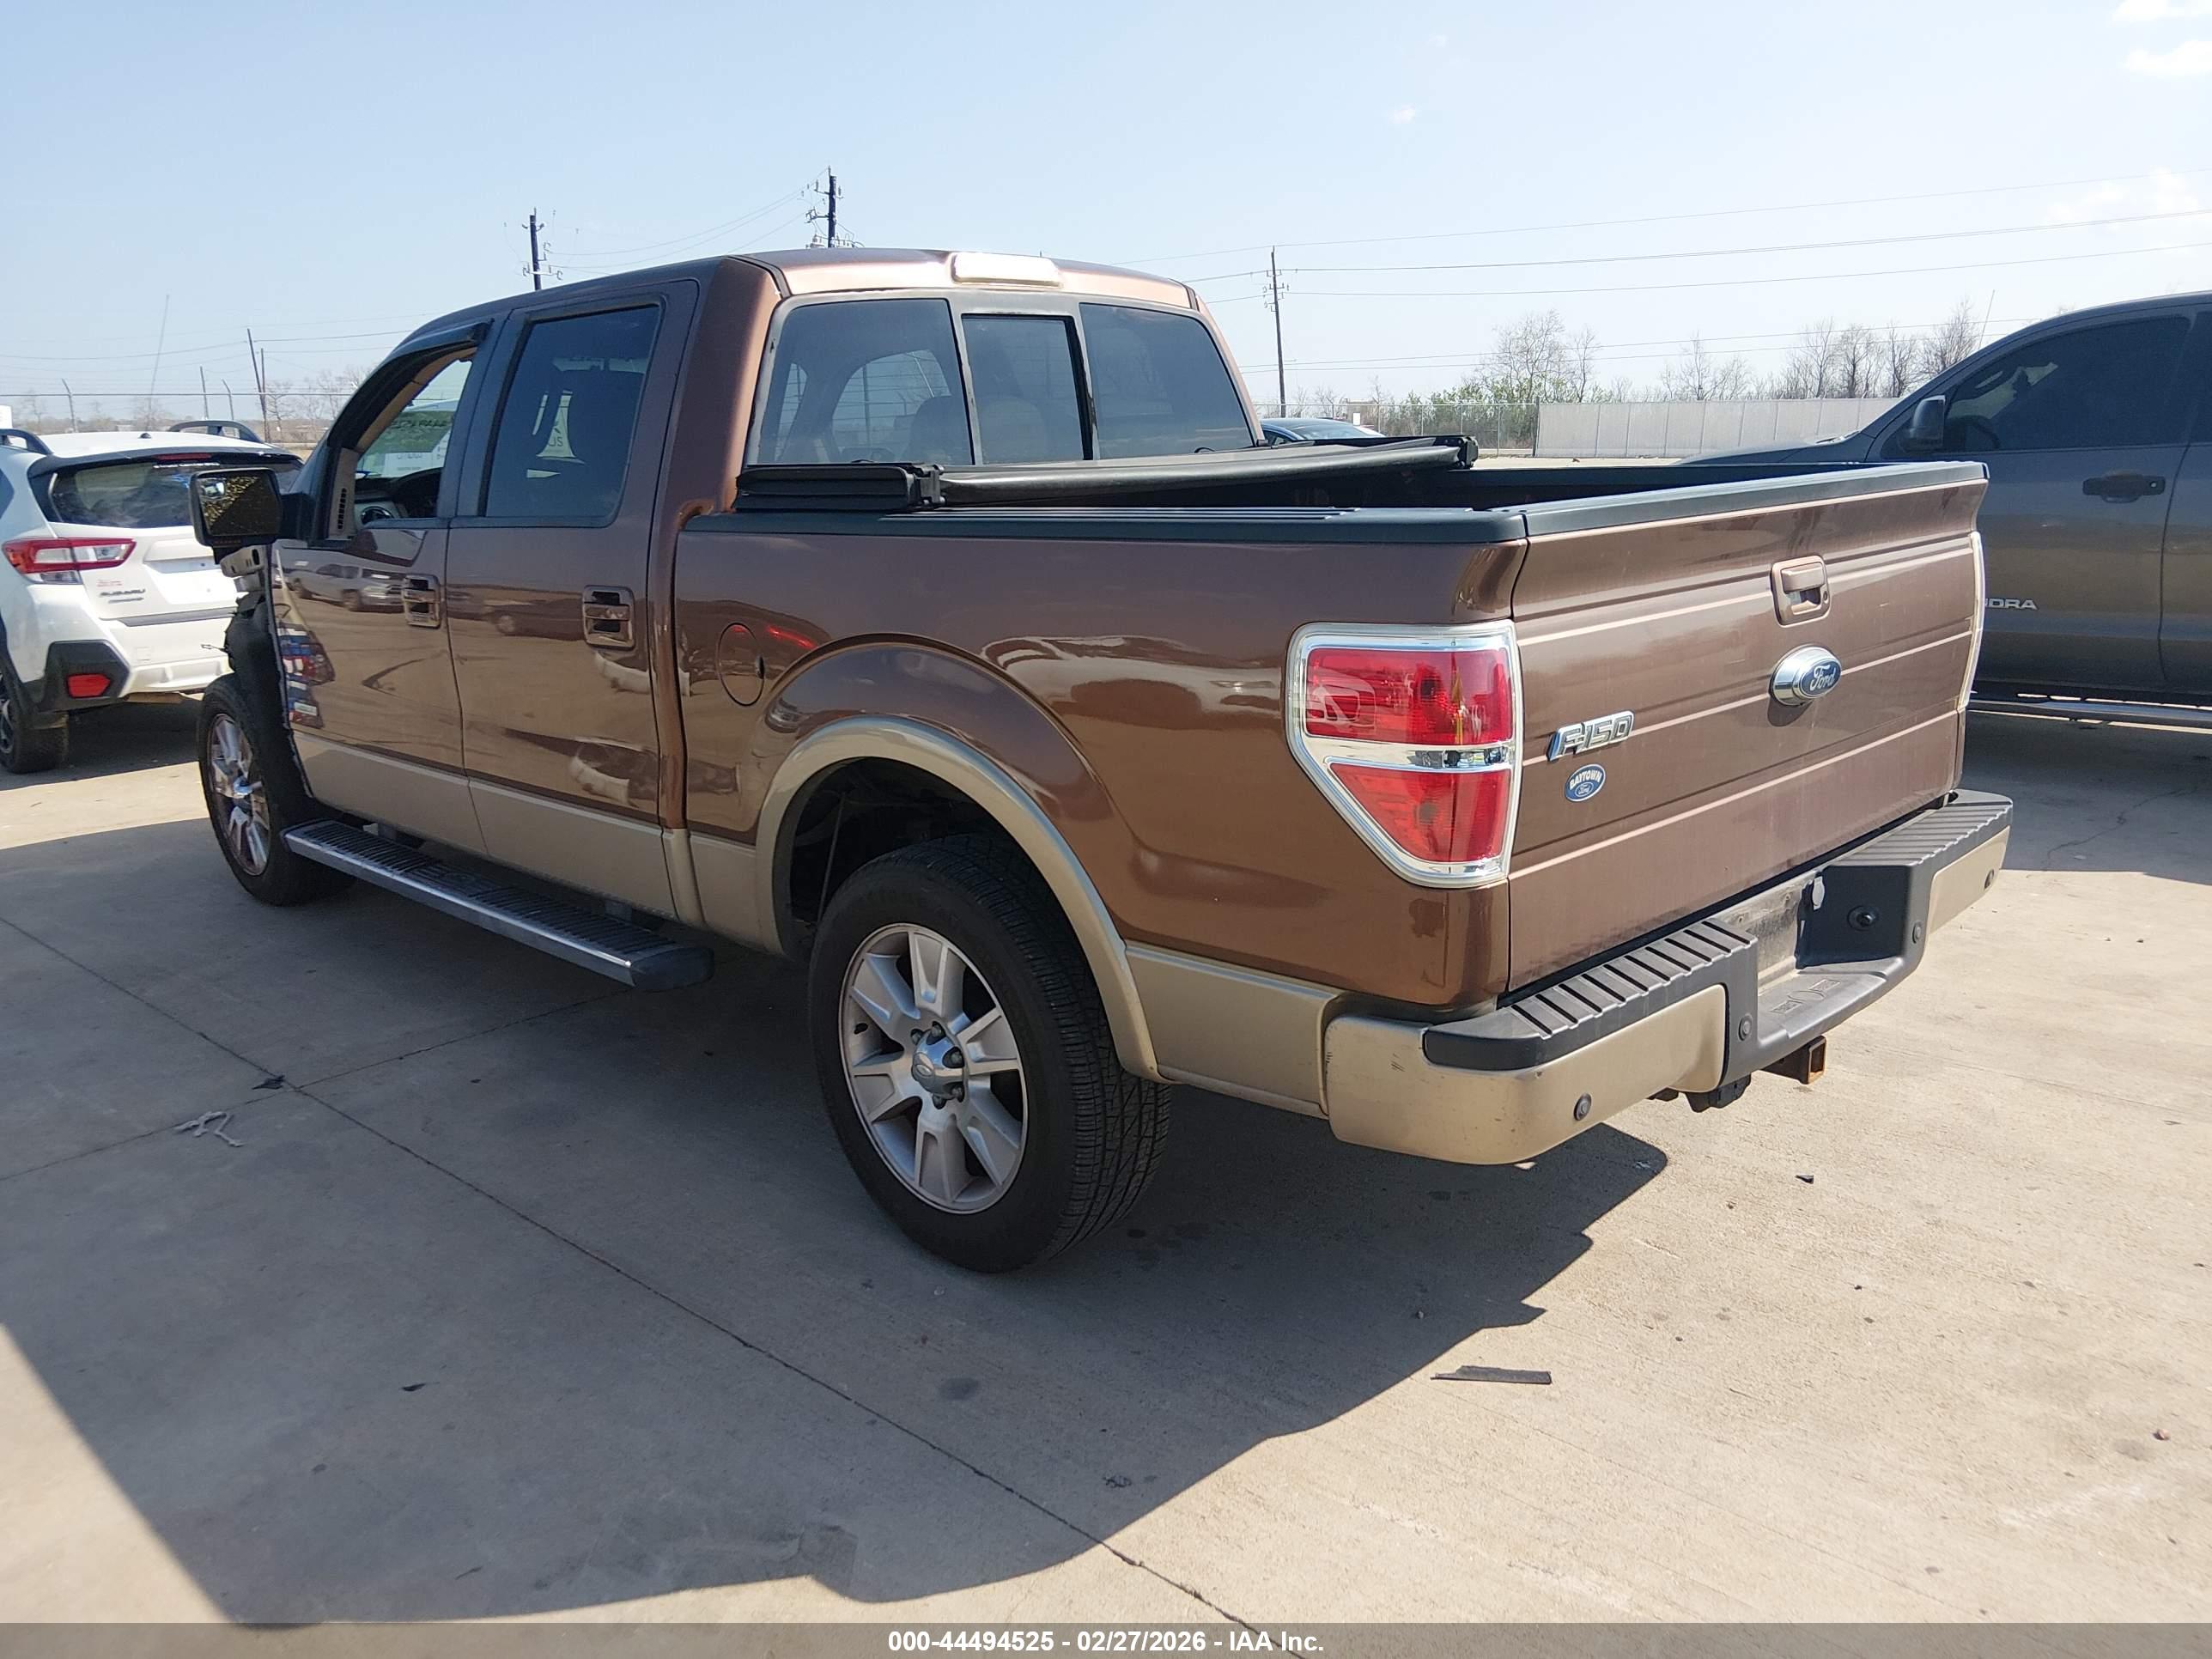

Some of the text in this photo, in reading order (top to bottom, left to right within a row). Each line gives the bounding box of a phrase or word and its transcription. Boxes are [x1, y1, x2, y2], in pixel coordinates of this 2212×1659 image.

[1985, 598, 2039, 611] DRA
[1809, 664, 1836, 691] Ford
[1549, 710, 1634, 761] F-150
[1569, 769, 1603, 791] BAYTOWN
